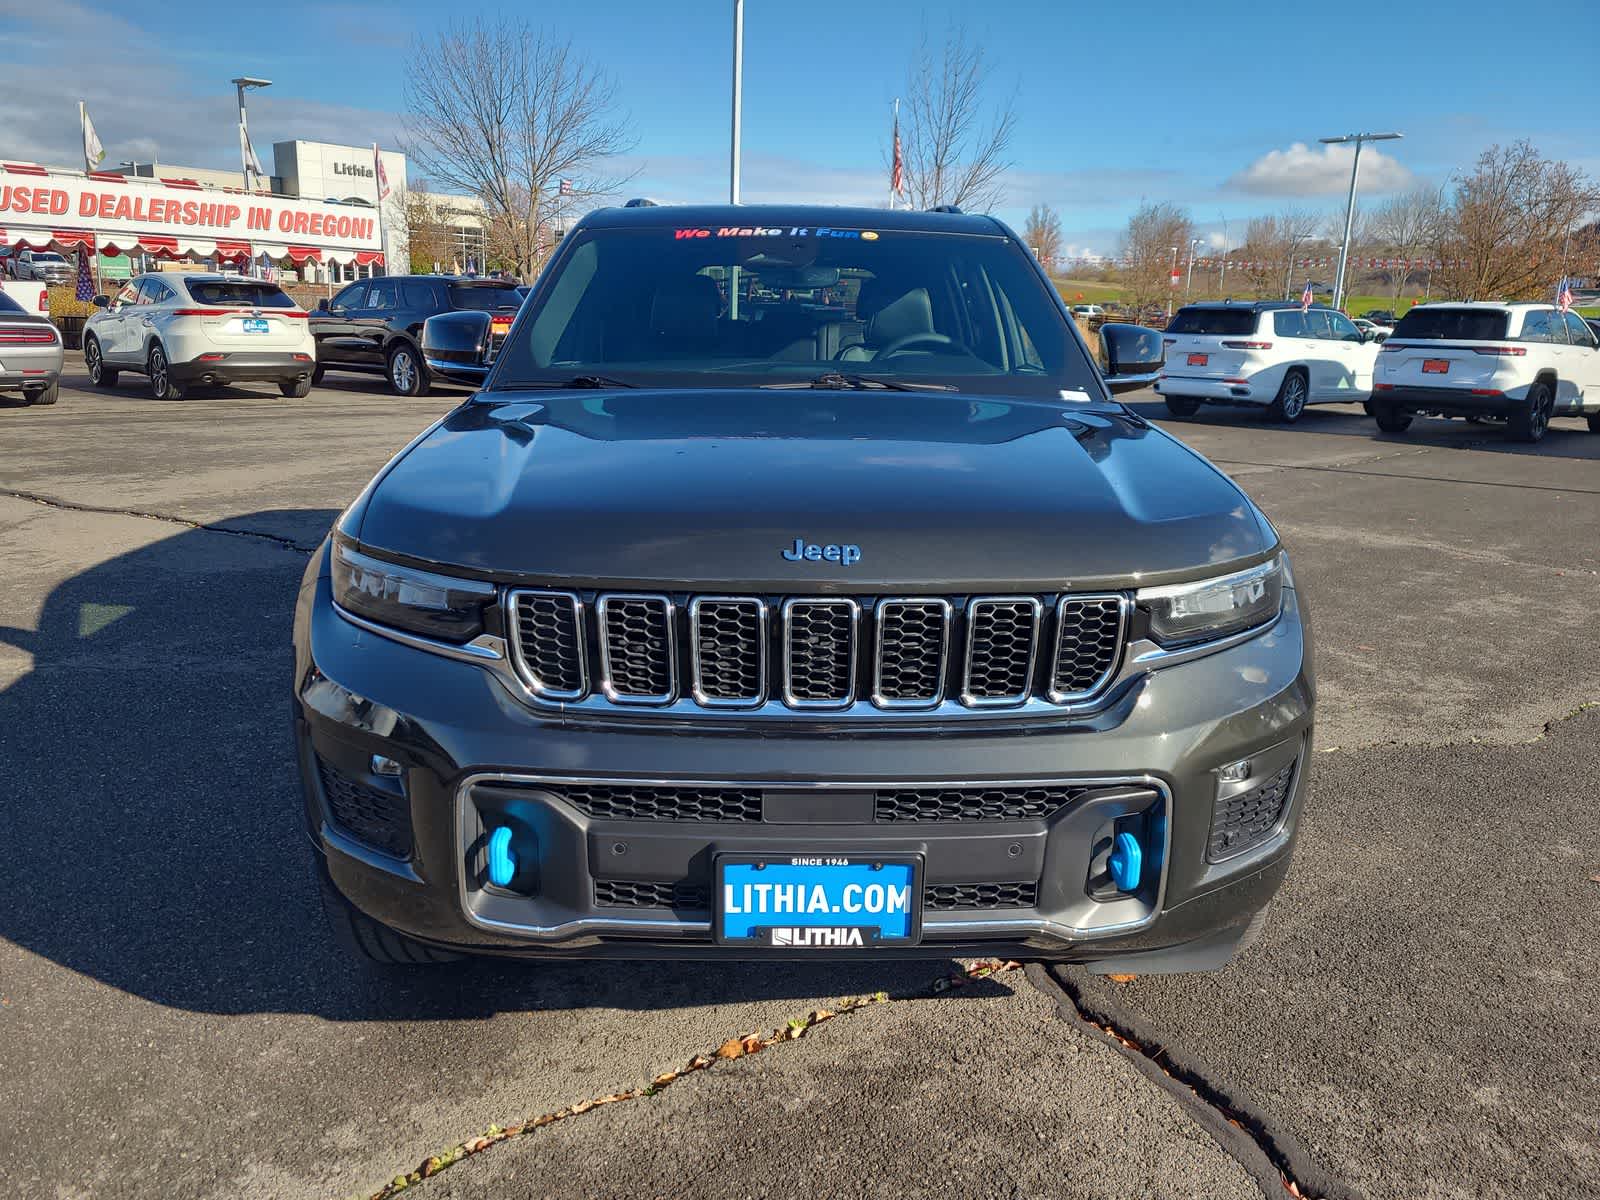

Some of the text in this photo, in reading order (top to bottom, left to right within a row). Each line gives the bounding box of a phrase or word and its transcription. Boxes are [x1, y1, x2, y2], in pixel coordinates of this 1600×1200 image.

[333, 162, 374, 178] Lithia
[79, 192, 241, 229] DEALERSHIP
[247, 206, 272, 231] IN
[278, 210, 375, 240] OREGON!
[674, 227, 860, 240] We Make It Fun
[782, 539, 861, 566] Jeep
[791, 858, 849, 866] SINCE 1946
[725, 884, 911, 914] LITHIA.COM
[793, 927, 864, 946] LITHIA
